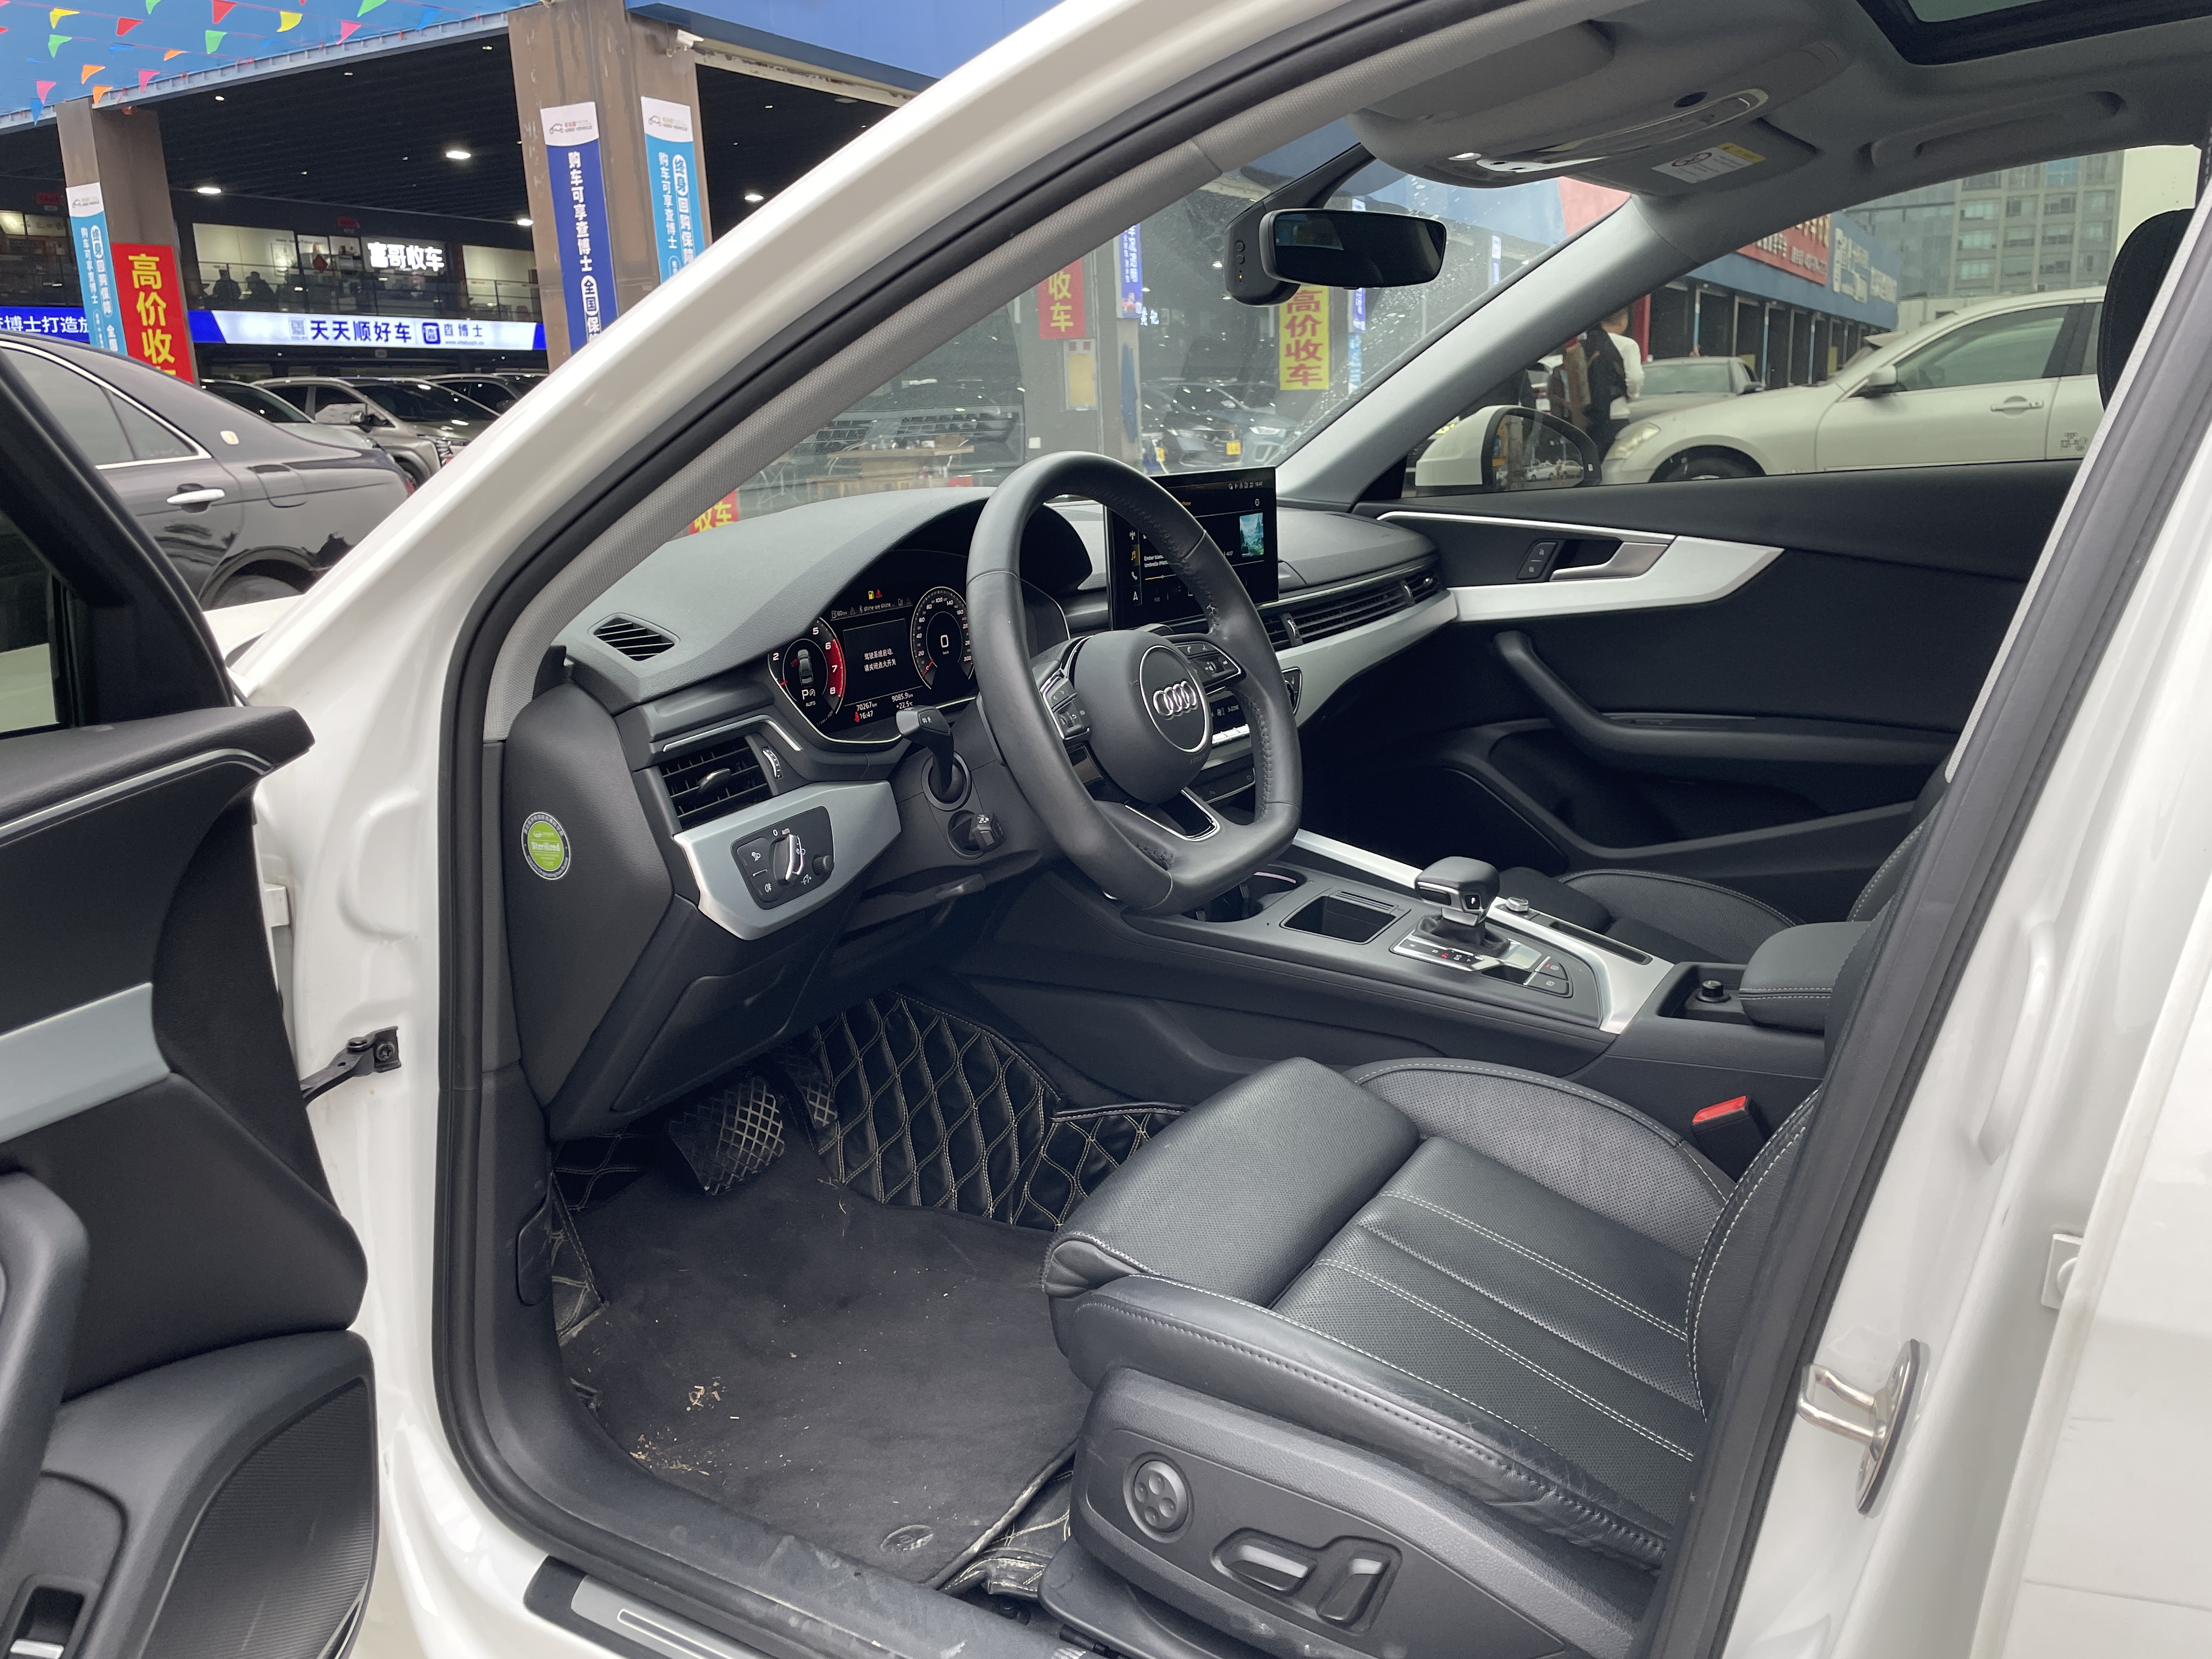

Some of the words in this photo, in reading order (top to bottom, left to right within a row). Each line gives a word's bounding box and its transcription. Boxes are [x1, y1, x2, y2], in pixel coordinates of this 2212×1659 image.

[568, 151, 592, 273] 购车可享查博士
[1048, 270, 1074, 332] 收车
[128, 253, 177, 376] 高价收
[310, 319, 412, 343] 天天顺好车
[443, 323, 483, 337] 查博士
[1284, 287, 1324, 387] 高价收车
[812, 627, 820, 635] 5
[825, 642, 832, 650] 6
[940, 634, 949, 648] 0
[772, 652, 780, 661] 2
[832, 664, 838, 673] 7
[802, 689, 809, 701] P
[830, 686, 836, 695] 8
[859, 710, 873, 720] 16:47
